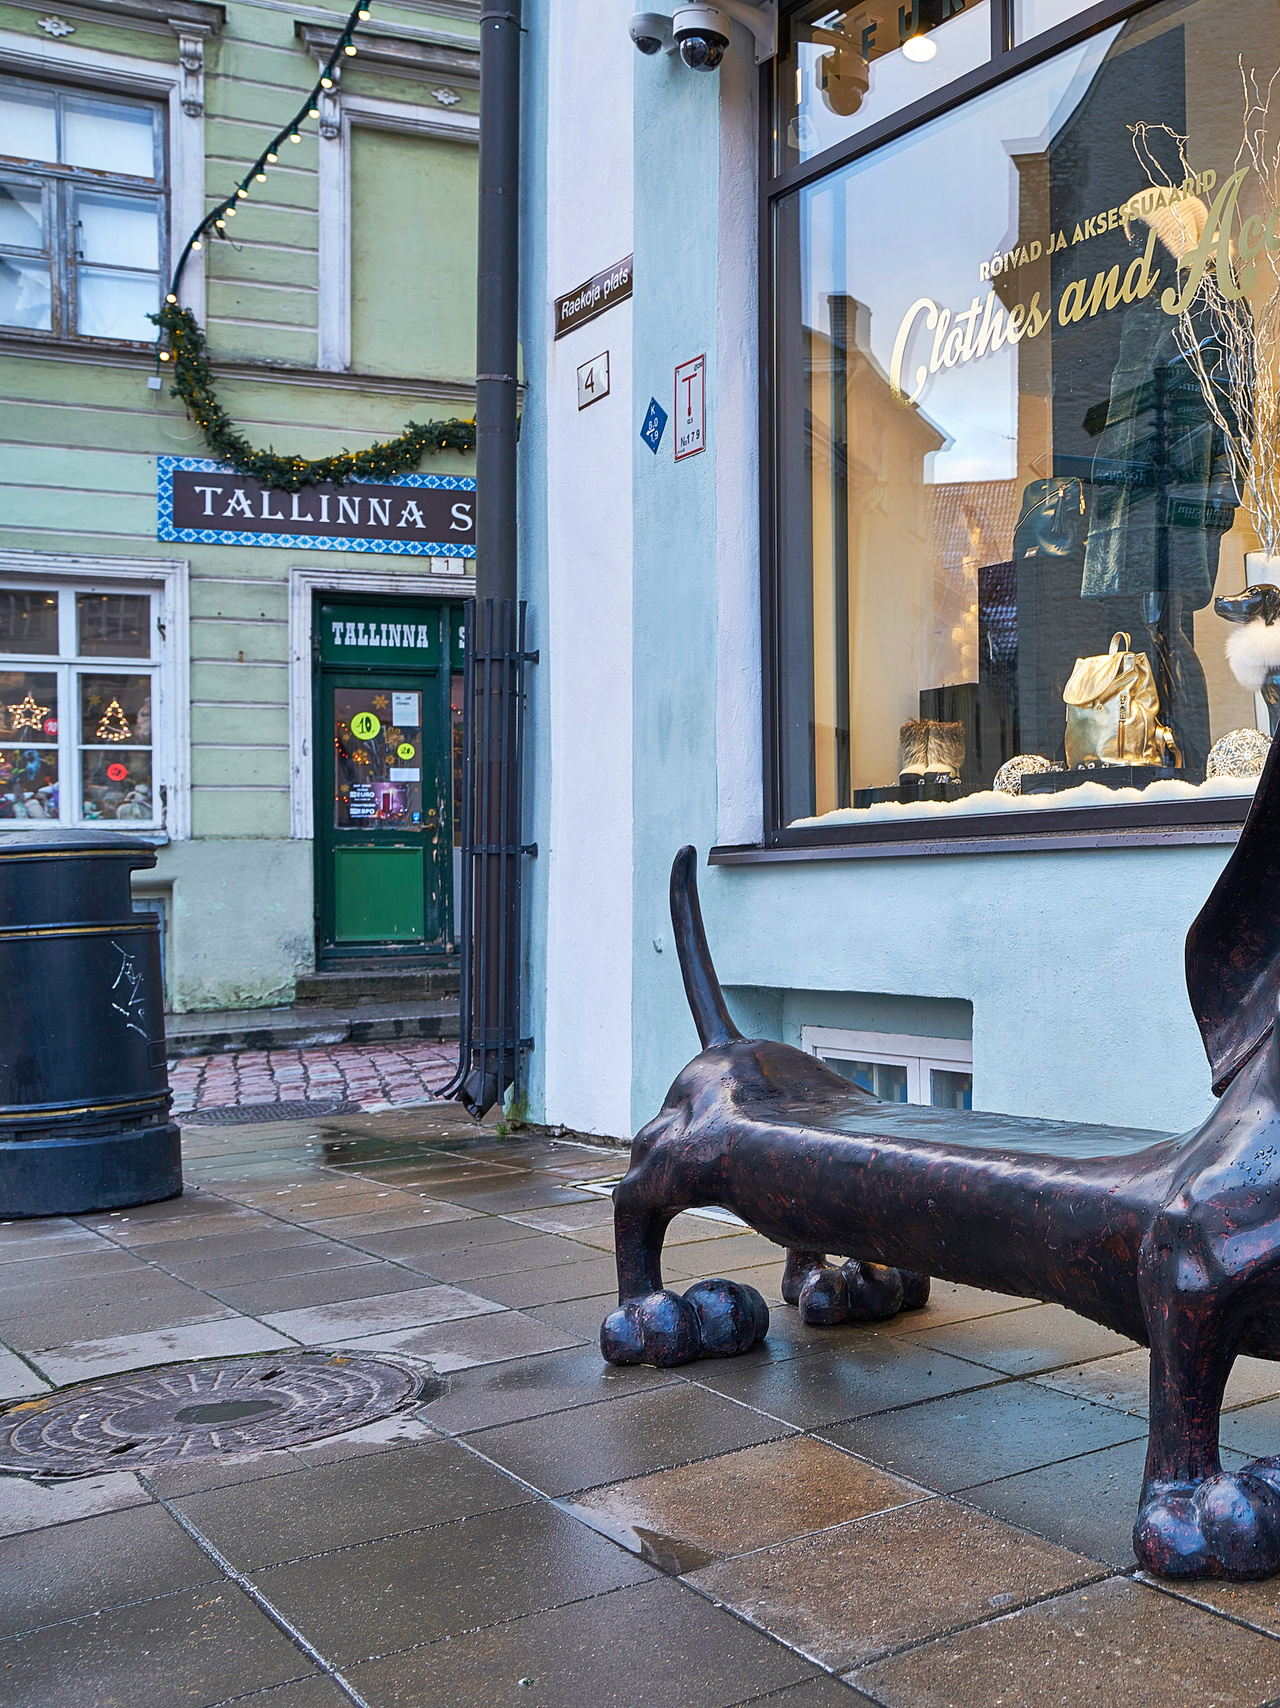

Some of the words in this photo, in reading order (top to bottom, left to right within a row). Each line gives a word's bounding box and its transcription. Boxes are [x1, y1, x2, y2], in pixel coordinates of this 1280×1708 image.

[979, 240, 1042, 282] RÕIVAD
[1045, 229, 1068, 256] JA
[1071, 168, 1217, 245] AKSESSUAARID
[561, 284, 601, 320] Raekoja
[603, 267, 629, 300] plats
[889, 290, 1052, 409] Clothes
[1057, 227, 1161, 328] and
[584, 366, 595, 394] 4
[650, 404, 656, 416] K
[193, 485, 427, 529] TALLINNA
[449, 502, 474, 532] S
[443, 558, 450, 572] 1
[331, 621, 429, 649] TALLINNA
